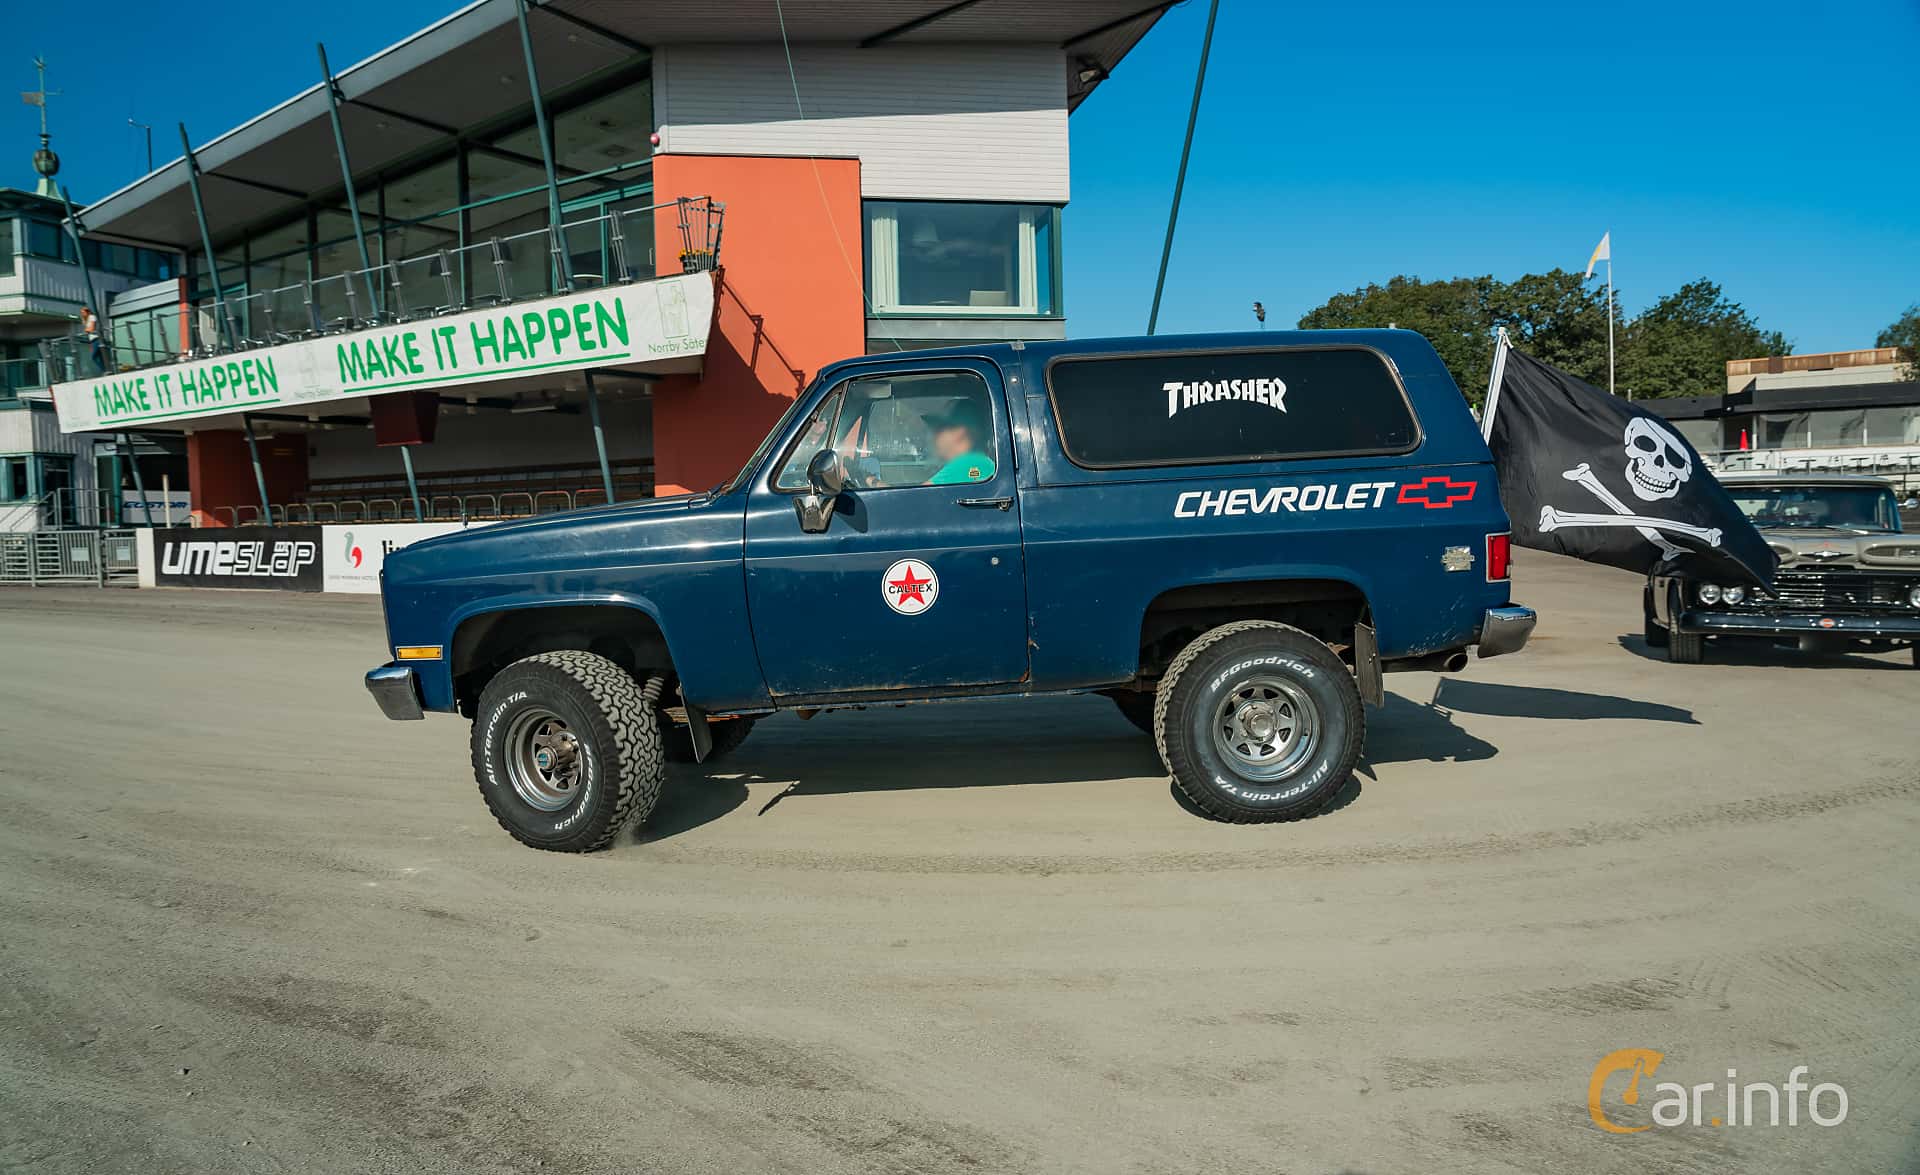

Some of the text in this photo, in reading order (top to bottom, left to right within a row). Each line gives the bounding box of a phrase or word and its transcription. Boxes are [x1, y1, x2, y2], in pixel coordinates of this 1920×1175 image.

[336, 296, 630, 384] MAKE IT HAPPEN
[648, 341, 680, 354] Norrby
[93, 355, 279, 417] MAKE IT HAPPEN
[1162, 377, 1288, 419] THRASHER
[1173, 481, 1396, 518] CHEVROLET
[888, 583, 933, 594] CALTEX
[1210, 655, 1315, 693] BFGoodrich
[484, 702, 507, 786] All-Terrain
[1241, 759, 1329, 801] All-Terrain
